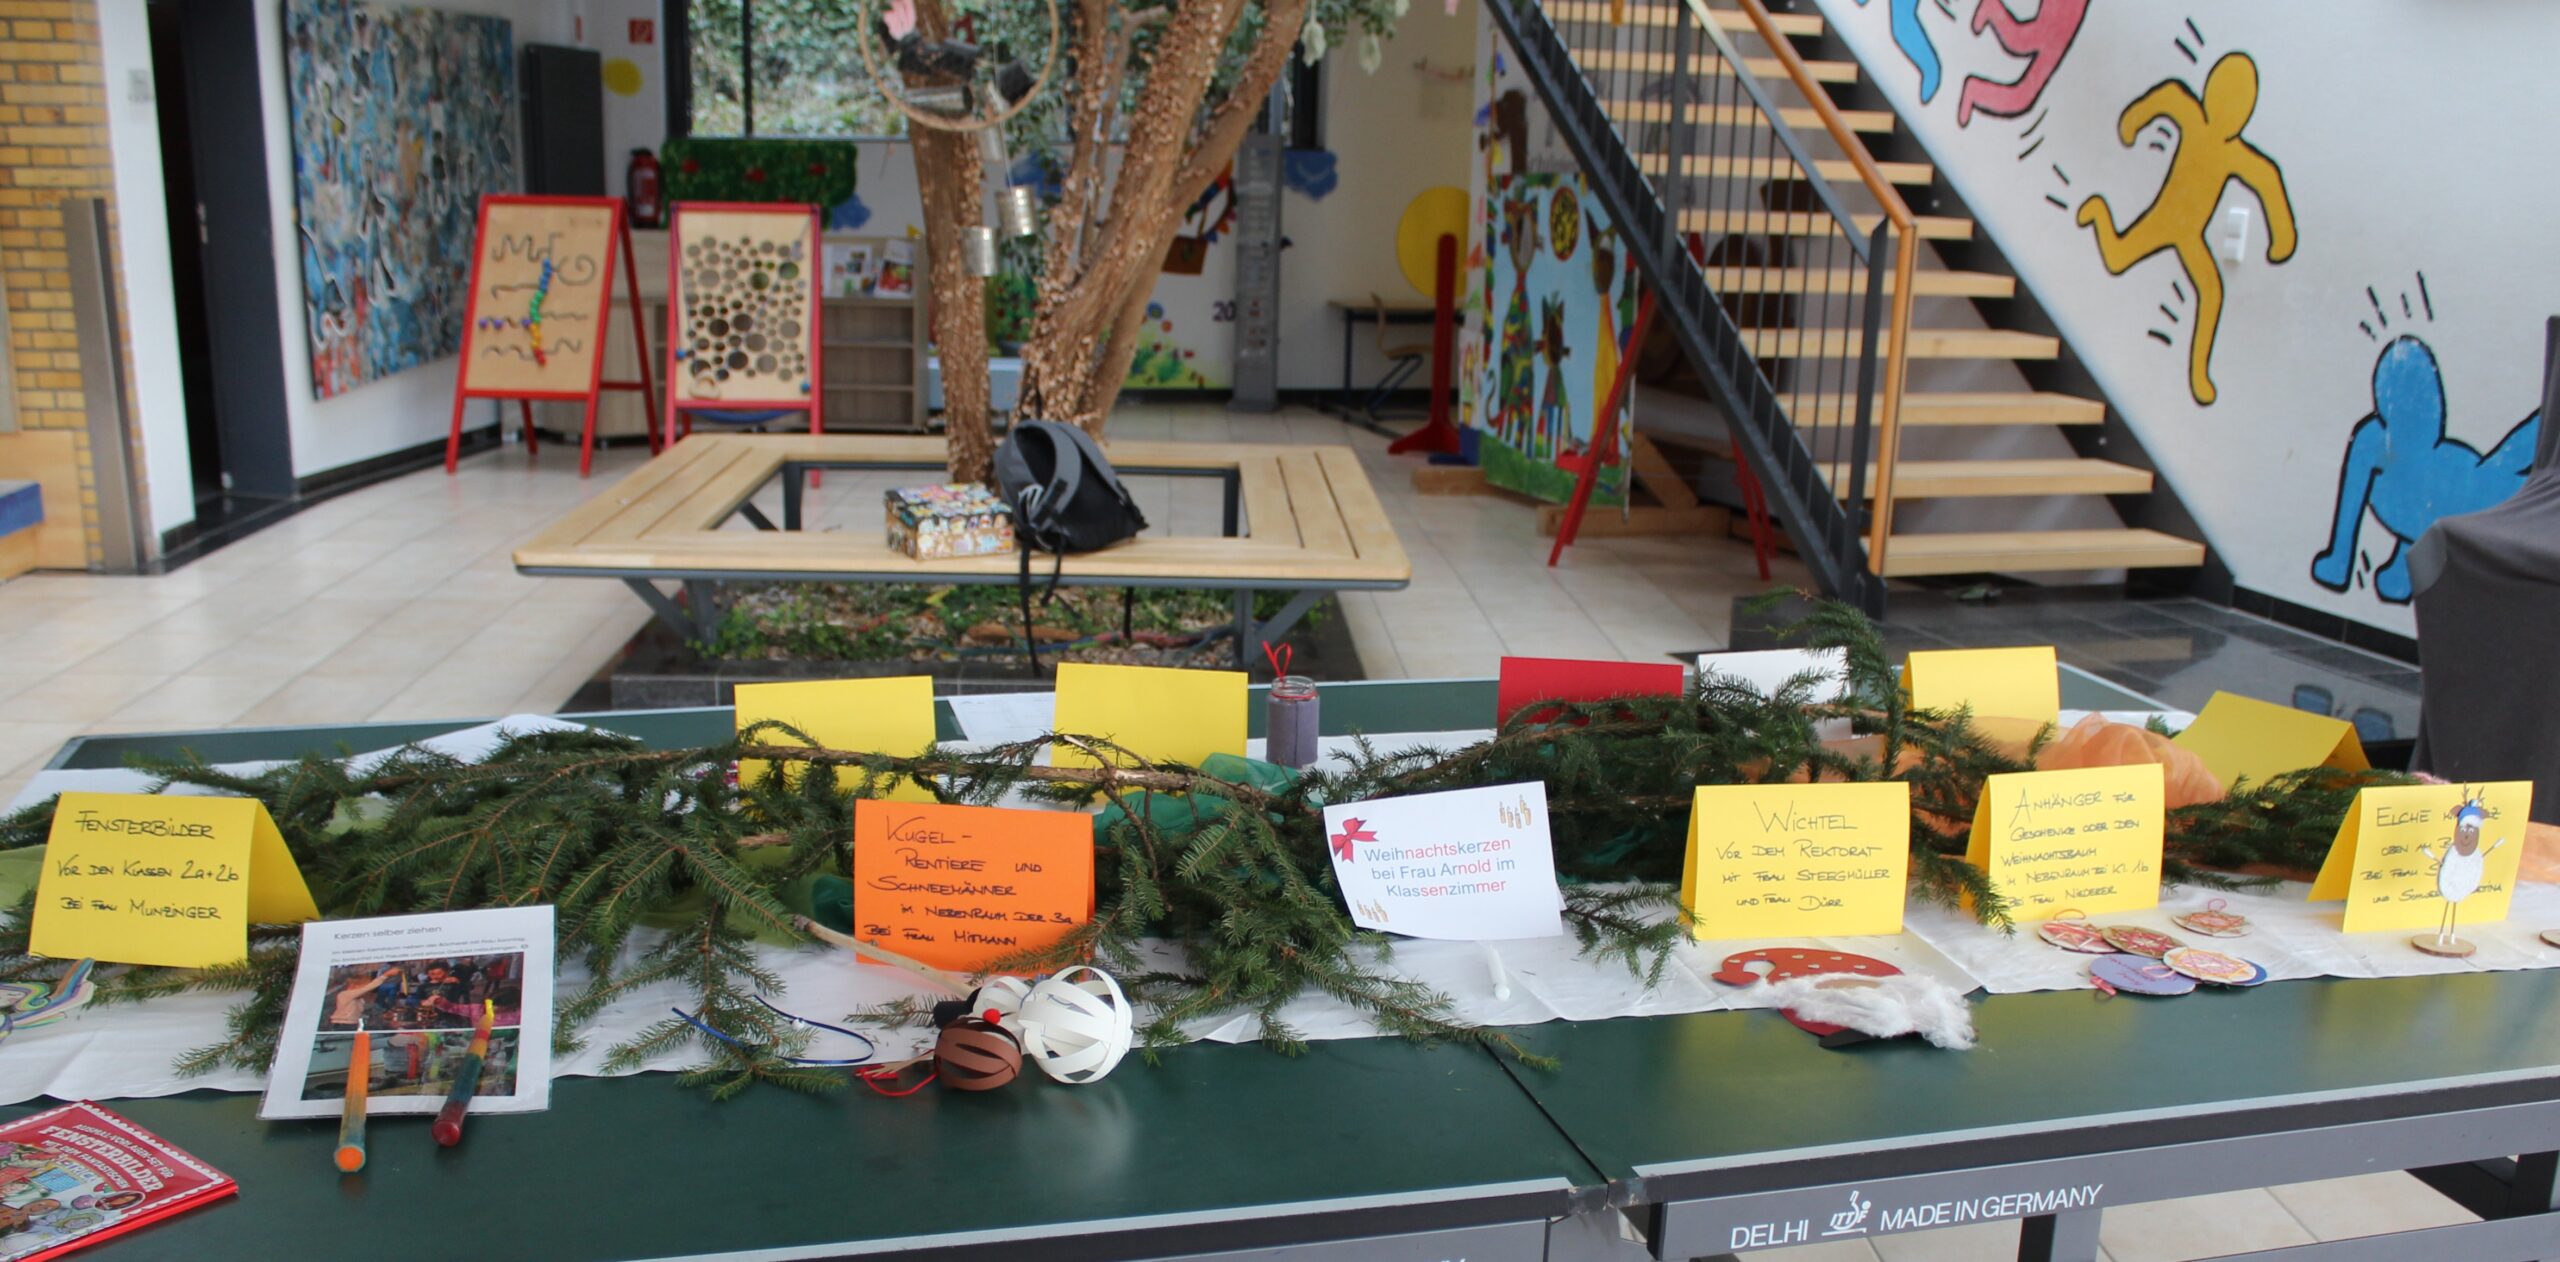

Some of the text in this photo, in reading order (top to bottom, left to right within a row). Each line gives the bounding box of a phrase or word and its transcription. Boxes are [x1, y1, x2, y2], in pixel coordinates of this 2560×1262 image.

[1364, 838, 1511, 862] Weihnachtskerzen
[1751, 845, 1786, 857] DEM
[57, 854, 81, 877] VOR
[88, 864, 114, 877] DEN
[1015, 862, 1043, 873] UND
[1371, 857, 1516, 881] bei Frau Arnold im
[1386, 880, 1507, 898] Klassenzimmer
[1012, 911, 1047, 923] DER
[334, 930, 371, 940] Kerzen
[38, 1125, 165, 1193] FENSTERBILDER
[1730, 1219, 1809, 1250] DELHI
[1880, 1201, 1951, 1232] MADE
[1954, 1198, 1978, 1221] IN
[1982, 1184, 2104, 1219] GERMANY
